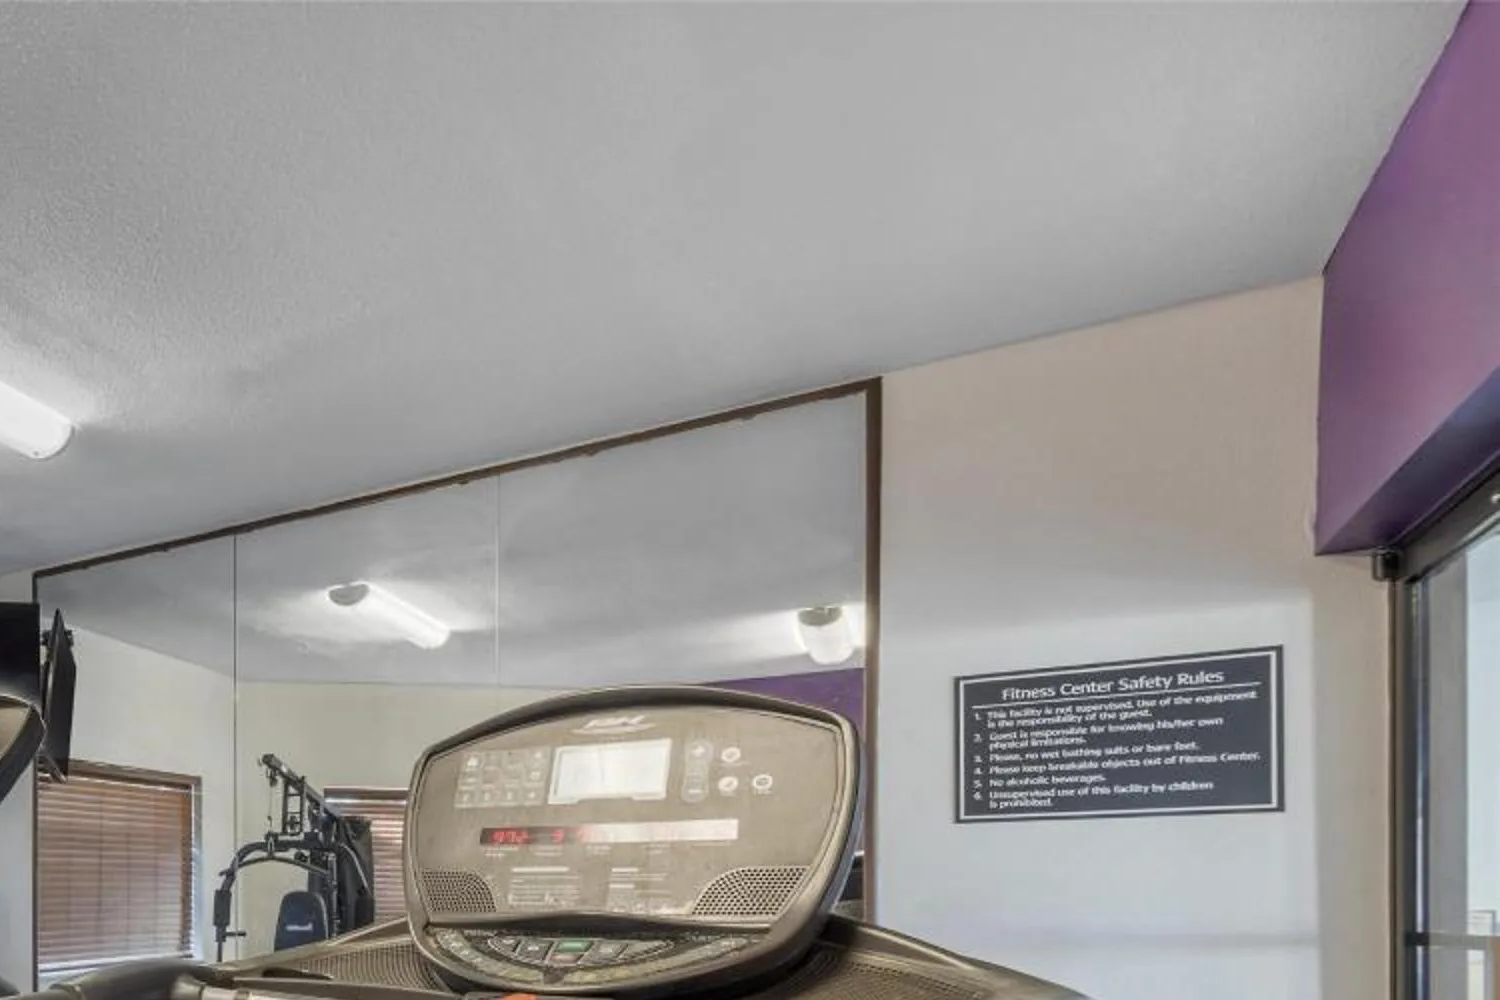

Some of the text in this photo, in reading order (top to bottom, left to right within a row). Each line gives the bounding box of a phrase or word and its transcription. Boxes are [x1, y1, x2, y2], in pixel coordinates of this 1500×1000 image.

[1002, 670, 1224, 700] Fitness Center Safety Rules
[987, 710, 1007, 719] This
[1009, 707, 1042, 718] facility
[1055, 705, 1073, 714] not
[1137, 699, 1156, 707] Use
[1159, 697, 1171, 706] of
[1174, 696, 1192, 705] the
[998, 718, 1015, 727] the
[1085, 712, 1097, 721] of
[1099, 711, 1116, 720] the
[989, 731, 1017, 741] Guest
[1090, 725, 1106, 733] for
[1197, 718, 1224, 727] own
[1025, 752, 1039, 760] no
[1041, 750, 1060, 759] wet
[1061, 747, 1102, 758] bathing
[1104, 745, 1129, 755] suits
[1131, 745, 1144, 753] or
[1146, 743, 1172, 753] bare
[989, 765, 1020, 774] Please
[1022, 764, 1046, 774] keep
[1101, 757, 1140, 769] objects
[1143, 757, 1162, 766] out
[1164, 755, 1177, 765] of
[1179, 754, 1217, 764] Fitness
[989, 779, 1004, 787] No
[1006, 776, 1050, 786] alcoholic
[1057, 788, 1075, 797] use
[1077, 786, 1090, 796] of
[1091, 785, 1111, 795] this
[1113, 783, 1149, 794] facility
[1151, 783, 1166, 793] by
[1168, 780, 1214, 792] children
